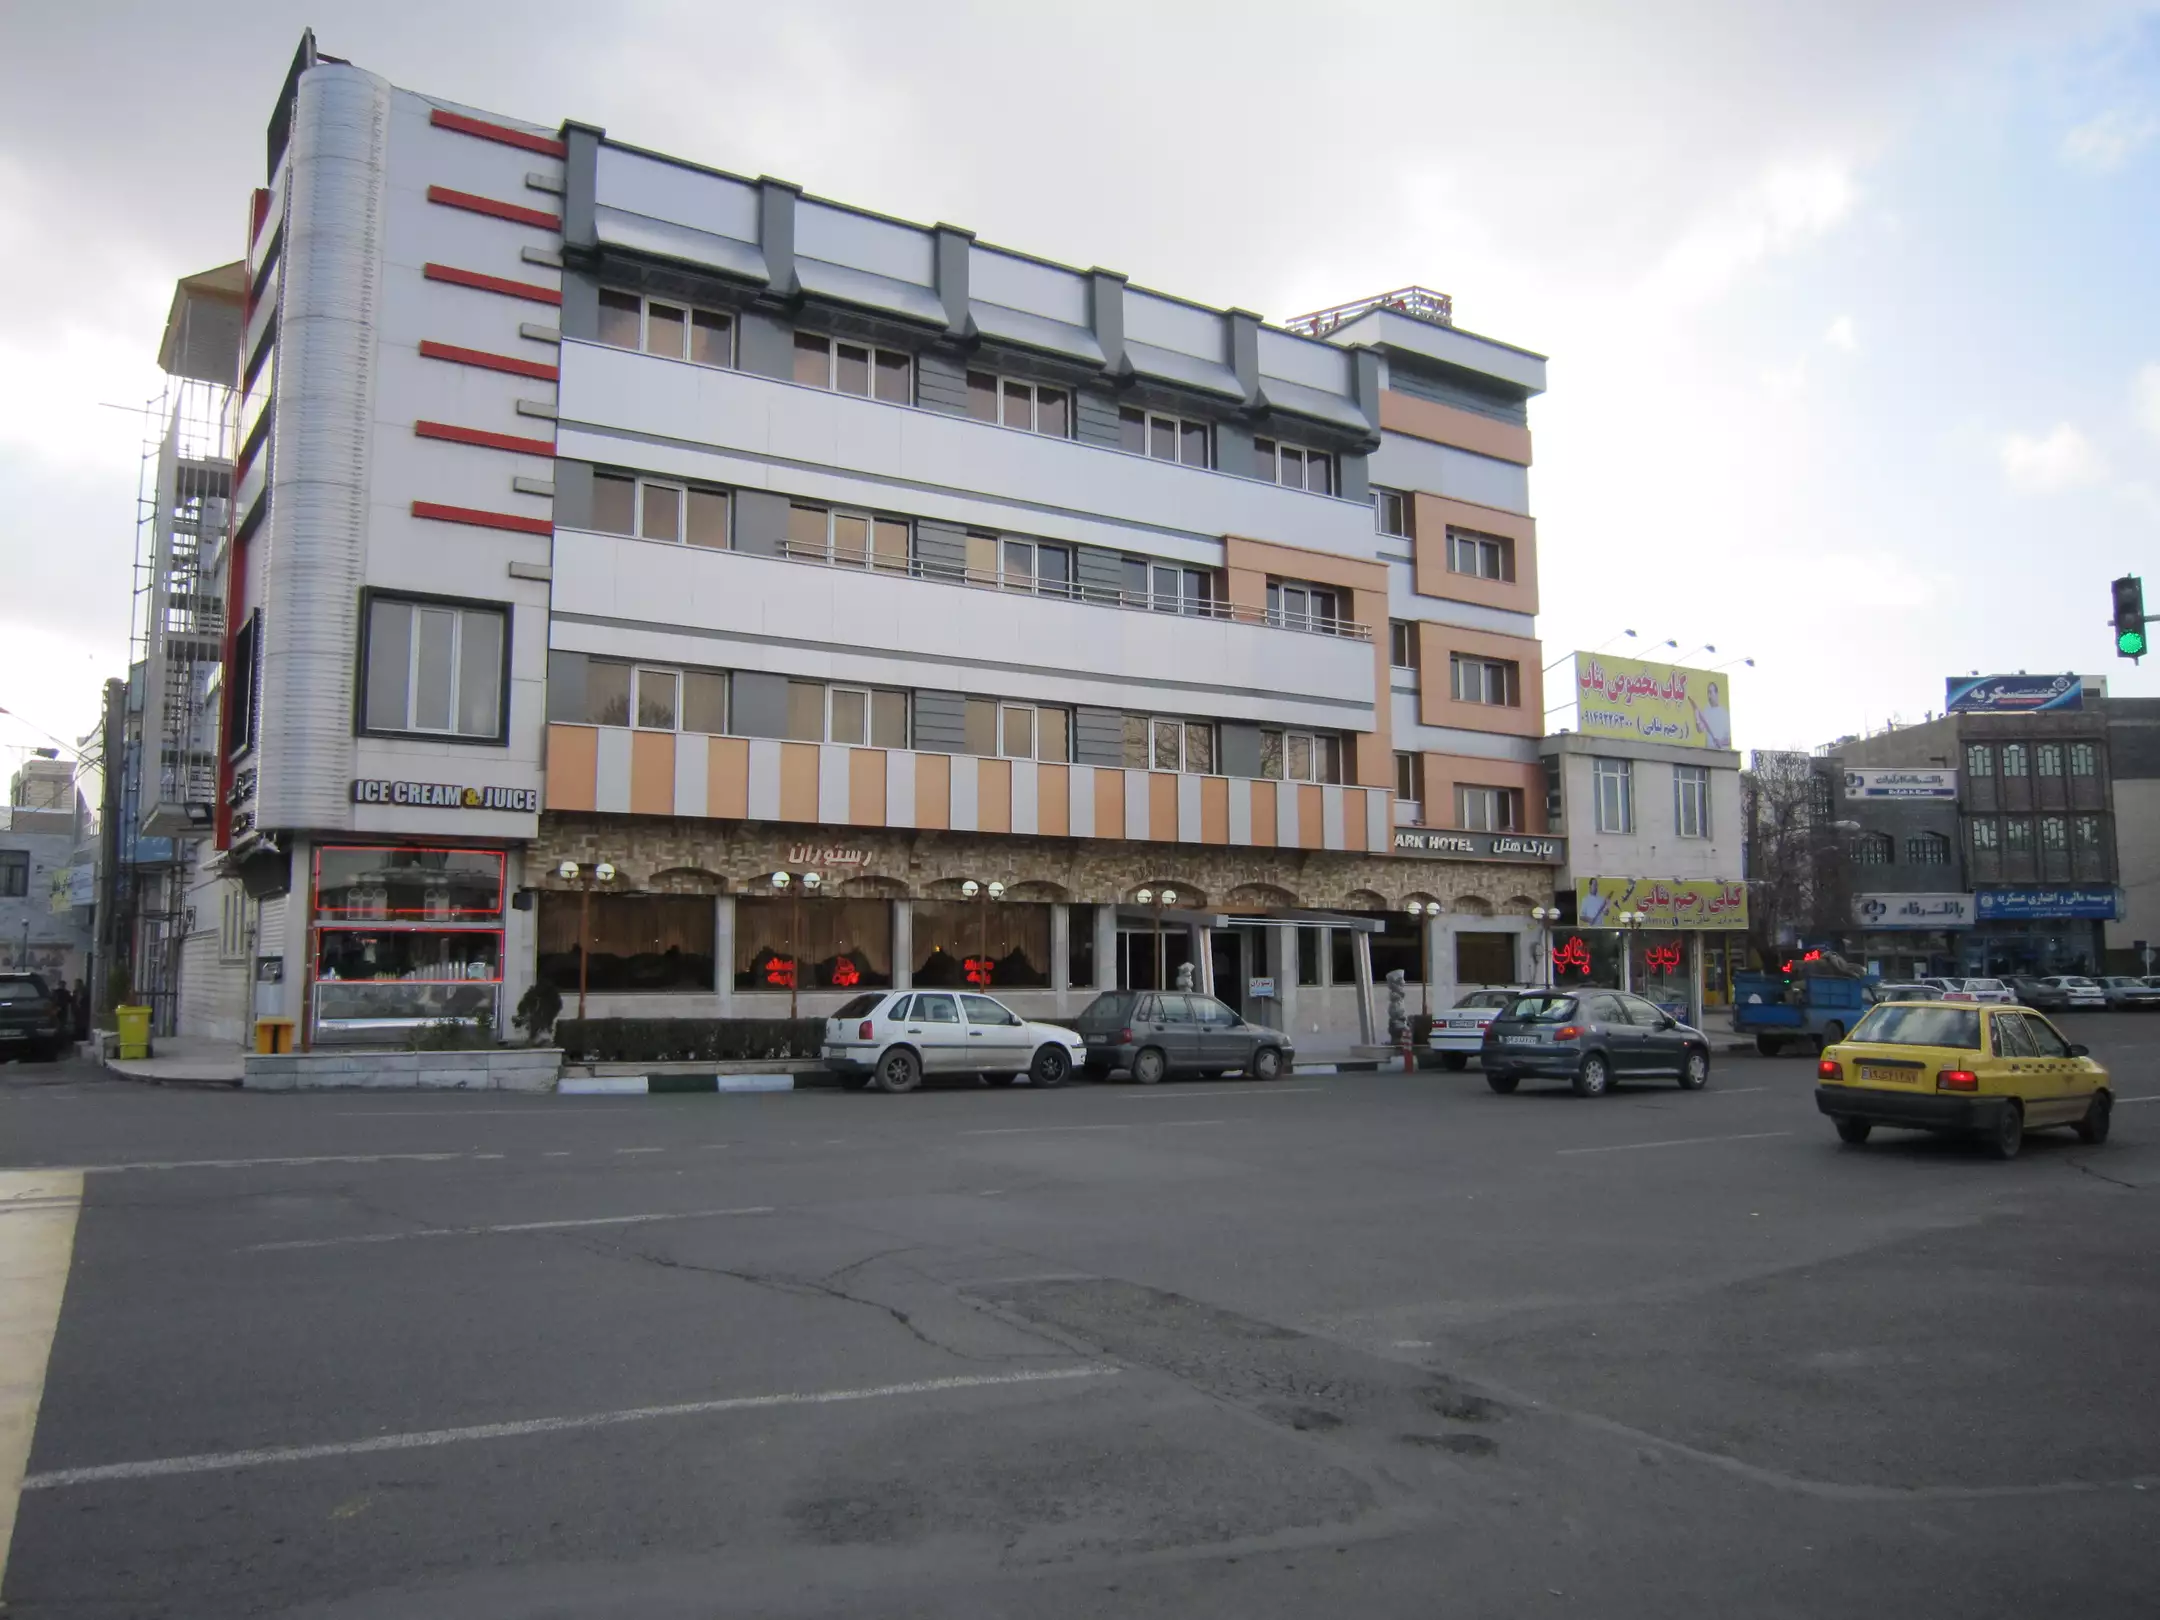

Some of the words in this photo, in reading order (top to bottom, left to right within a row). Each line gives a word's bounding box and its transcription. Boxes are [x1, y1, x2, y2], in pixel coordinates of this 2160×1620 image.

[1578, 657, 1606, 699] بناب
[1606, 667, 1660, 706] مخصوص
[1660, 669, 1688, 708] کباب
[1970, 685, 2057, 704] عسکریه
[356, 780, 391, 803] ICE
[393, 781, 463, 807] CREAM
[463, 787, 482, 808] &
[484, 786, 537, 811] JUICE
[788, 842, 873, 867] رستوران
[1393, 834, 1425, 849] ARK
[1428, 836, 1475, 851] HOTEL
[1492, 838, 1521, 854] هتل
[1522, 840, 1553, 860] پارک
[1635, 882, 1670, 912] بنابی
[1672, 890, 1705, 915] رحیم
[1707, 885, 1743, 915] کبابی
[1899, 901, 1926, 917] رفاه
[1926, 901, 1965, 919] بانک
[1552, 936, 1591, 975] بناب
[1250, 979, 1273, 988] رستوران
